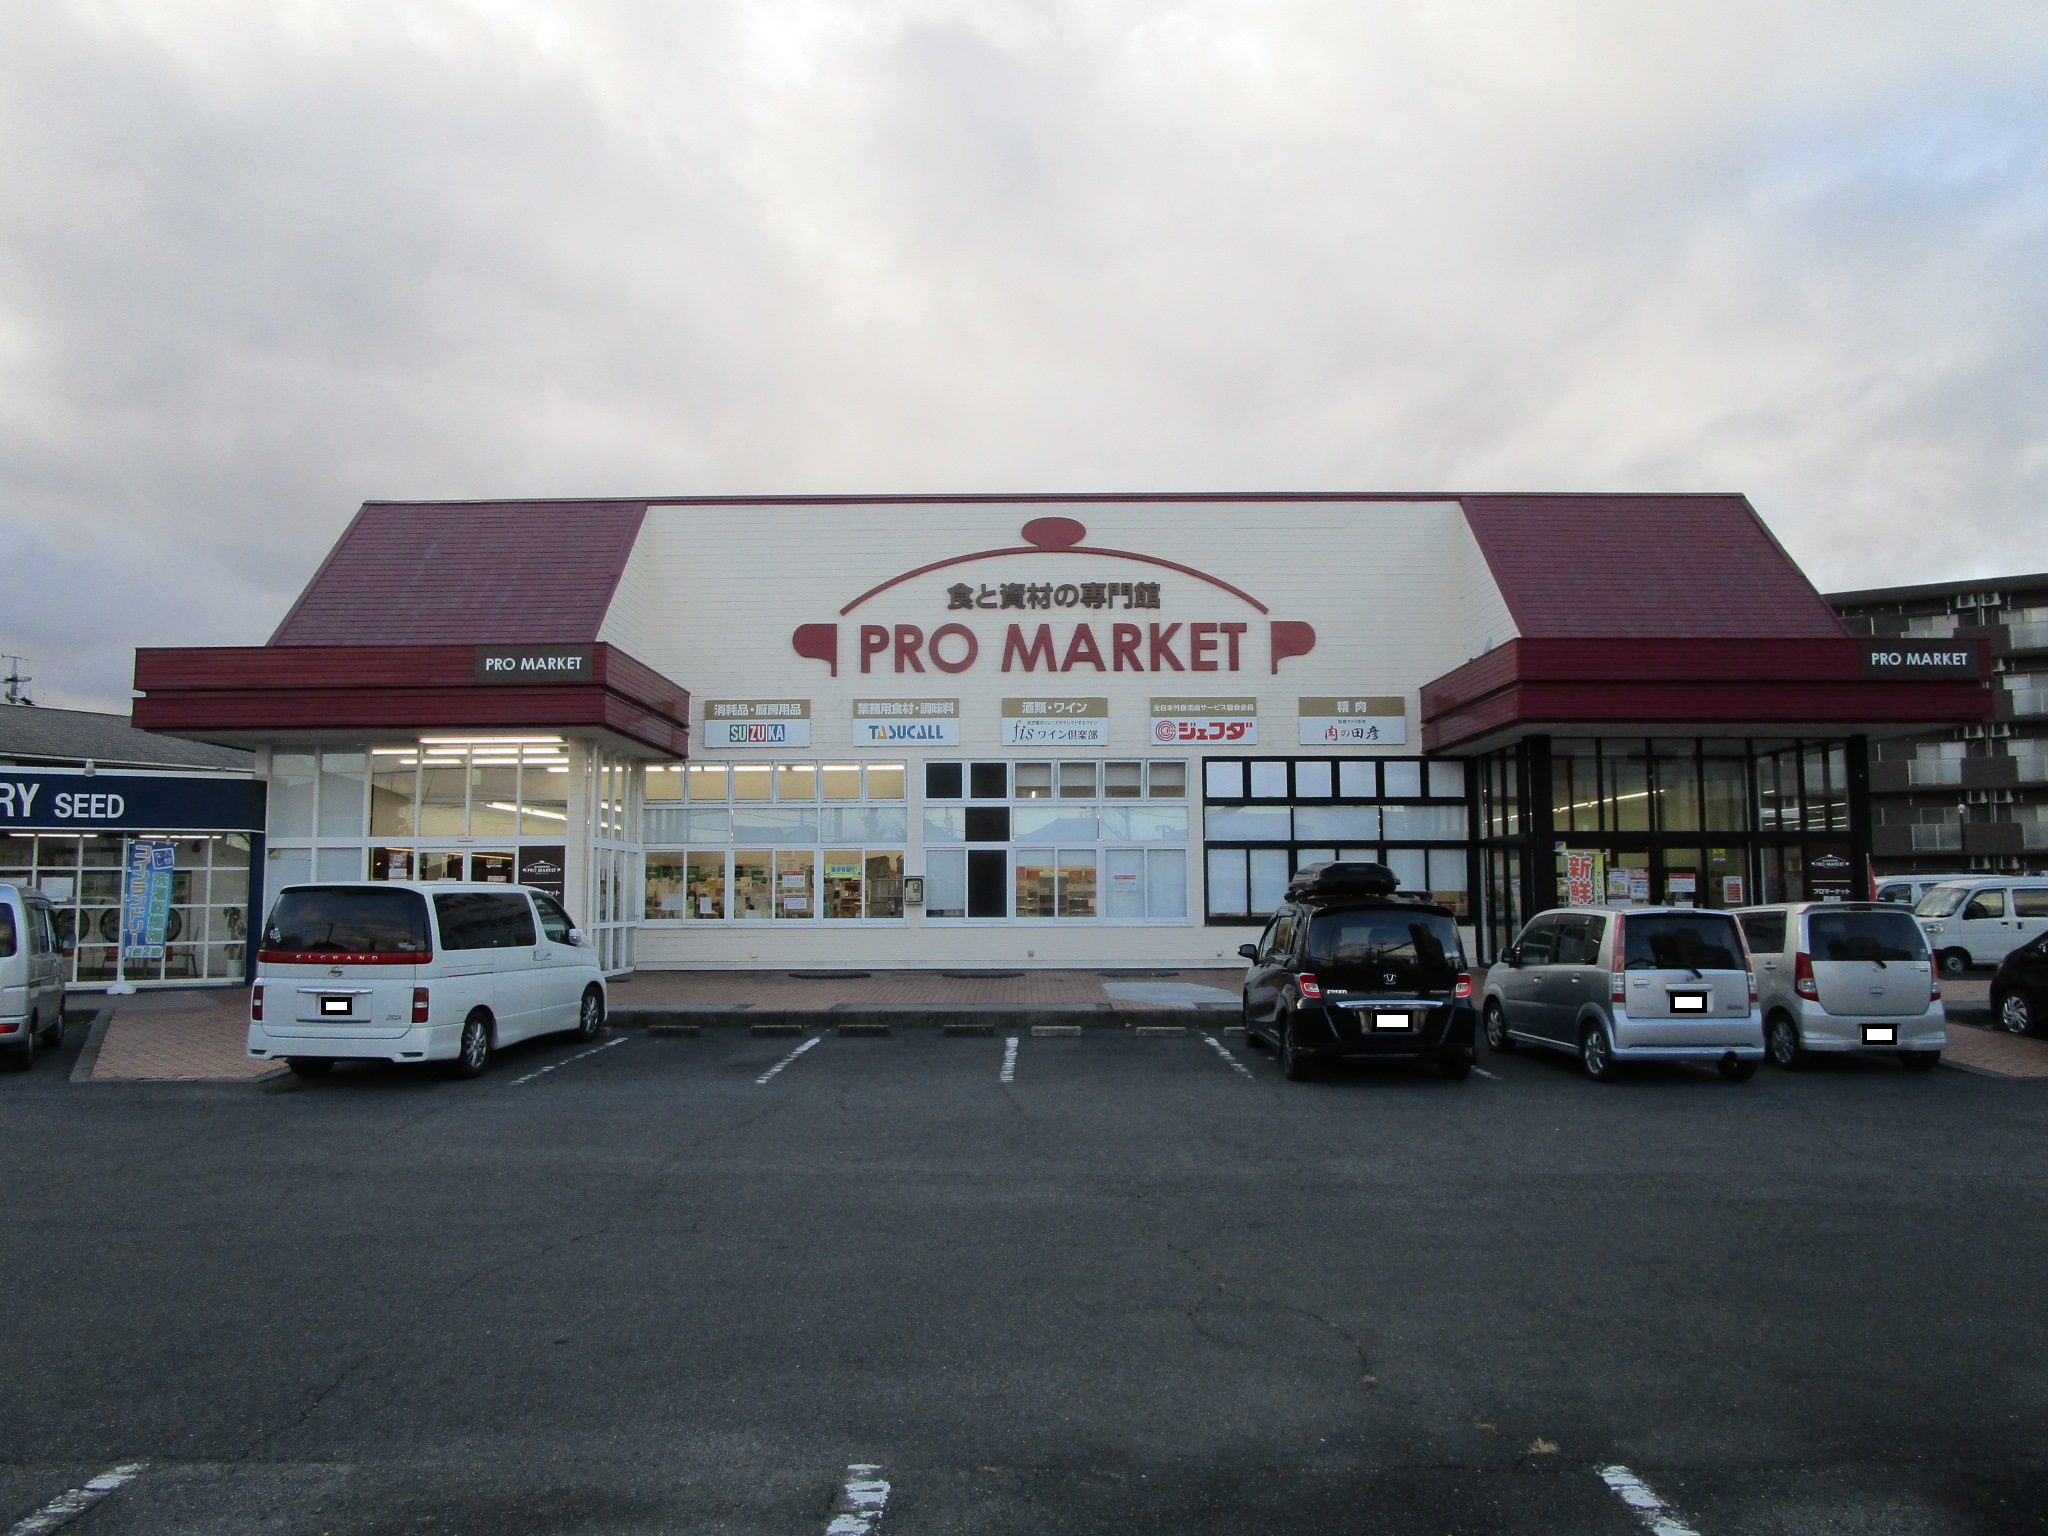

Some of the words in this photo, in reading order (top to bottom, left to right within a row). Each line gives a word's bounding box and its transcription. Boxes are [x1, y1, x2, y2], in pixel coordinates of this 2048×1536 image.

[947, 582, 1161, 610] 食と資材の専門館
[860, 622, 979, 674] PRO
[1001, 621, 1248, 673] MARKET
[485, 657, 516, 671] PRO
[520, 656, 583, 671] MARKET
[1871, 652, 1902, 666] PRO
[1906, 652, 1968, 666] MARKET
[714, 703, 802, 717] 消耗品・厨房用品
[857, 702, 955, 715] 業務用食材・調味料
[1022, 701, 1088, 714] 酒類・ワイン
[730, 724, 785, 742] SUZUKA
[868, 724, 944, 740] TASUCALL
[1012, 720, 1035, 743] fis
[1037, 730, 1098, 740] ワイン倶楽部
[1178, 722, 1253, 741] ジェフダ
[1324, 725, 1380, 741] 肉の田彦
[0, 783, 40, 817] RY
[54, 793, 125, 819] SEED
[1568, 855, 1593, 907] 新鮮
[129, 845, 153, 946] コインランドリー
